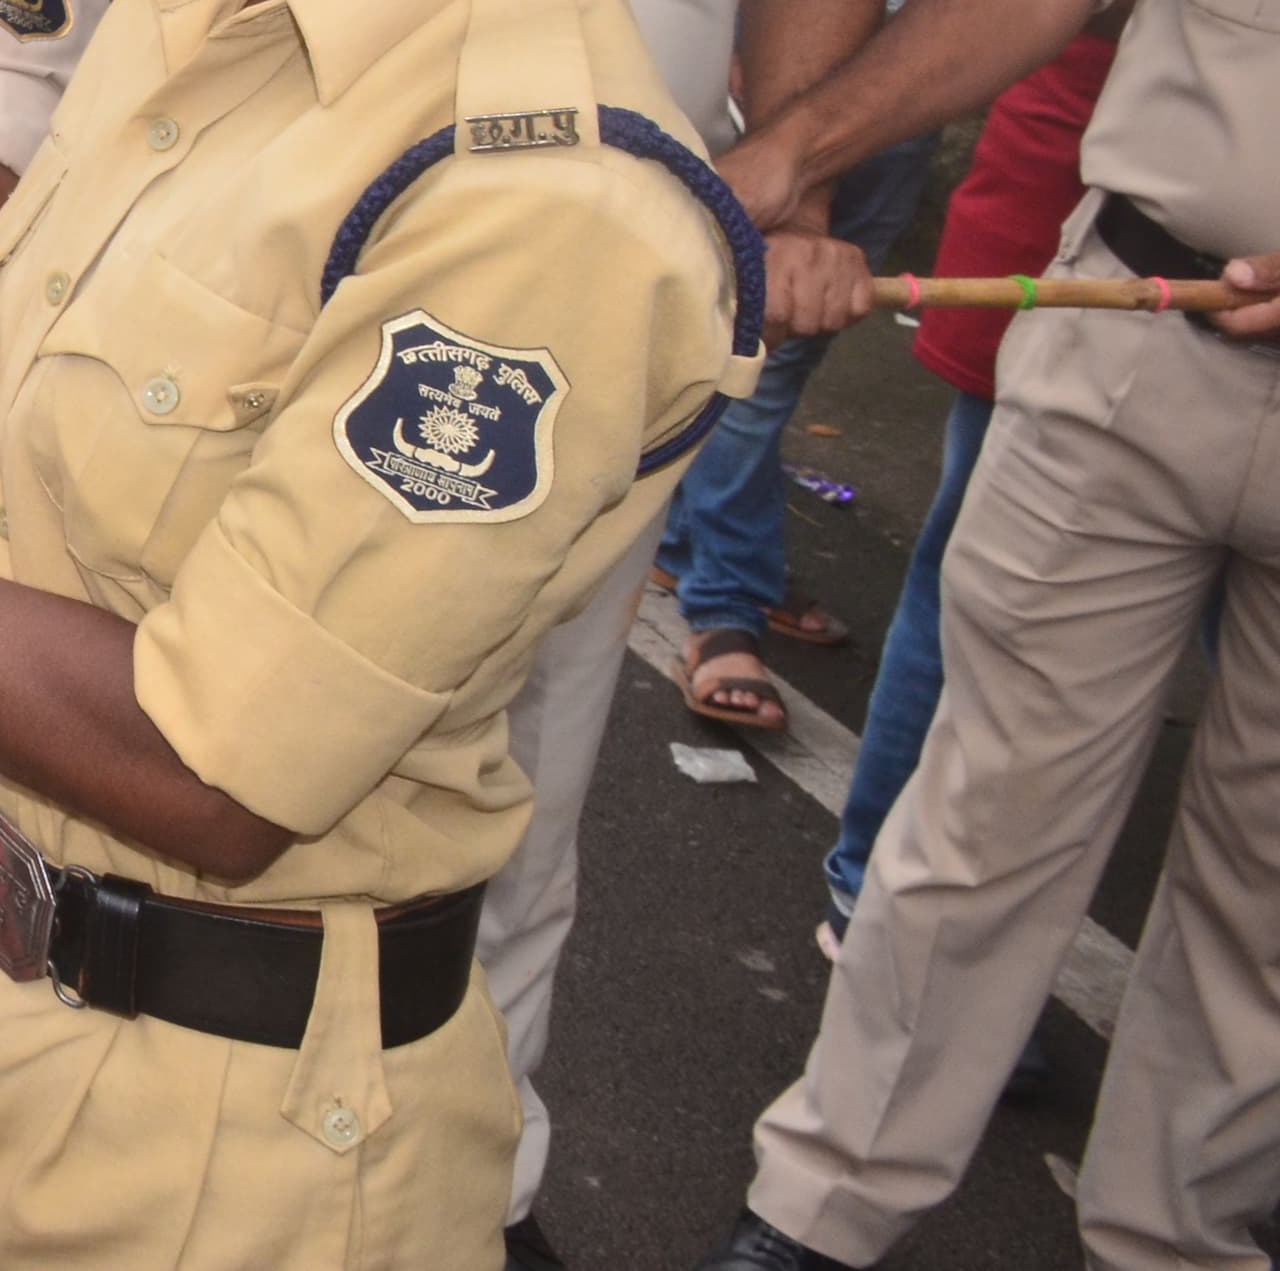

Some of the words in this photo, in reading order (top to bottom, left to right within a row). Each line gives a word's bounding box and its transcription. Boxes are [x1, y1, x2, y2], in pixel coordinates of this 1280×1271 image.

[418, 383, 463, 409] सत्यमेव
[468, 402, 503, 422] जयते
[492, 362, 543, 406] पुलिस
[399, 478, 451, 506] 2000
